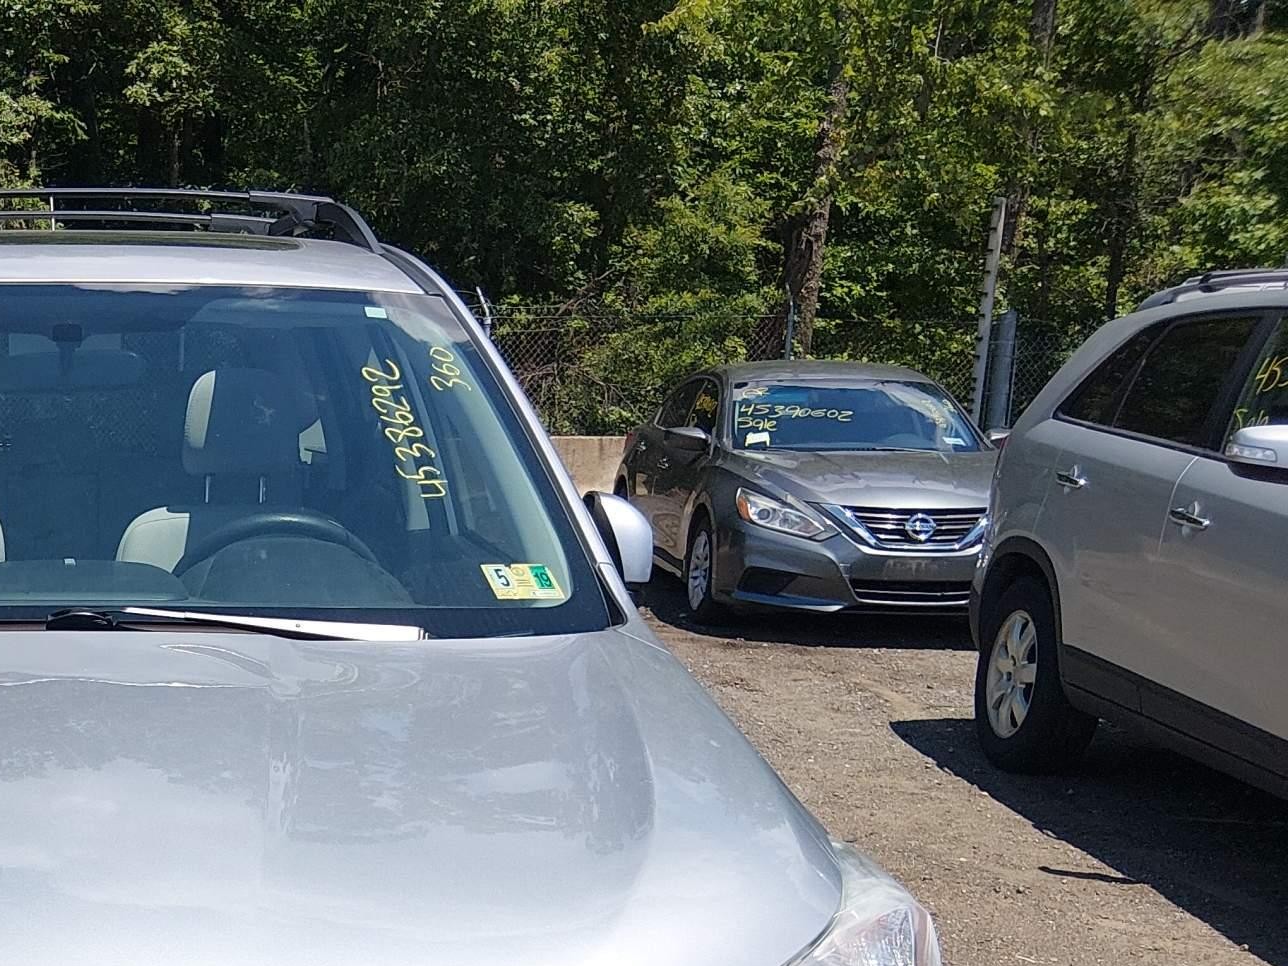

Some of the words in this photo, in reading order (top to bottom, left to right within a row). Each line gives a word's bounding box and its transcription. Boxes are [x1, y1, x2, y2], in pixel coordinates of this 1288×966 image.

[430, 346, 472, 391] 360
[362, 359, 448, 498] 45386292
[493, 568, 510, 587] 5
[533, 571, 553, 588] 19
